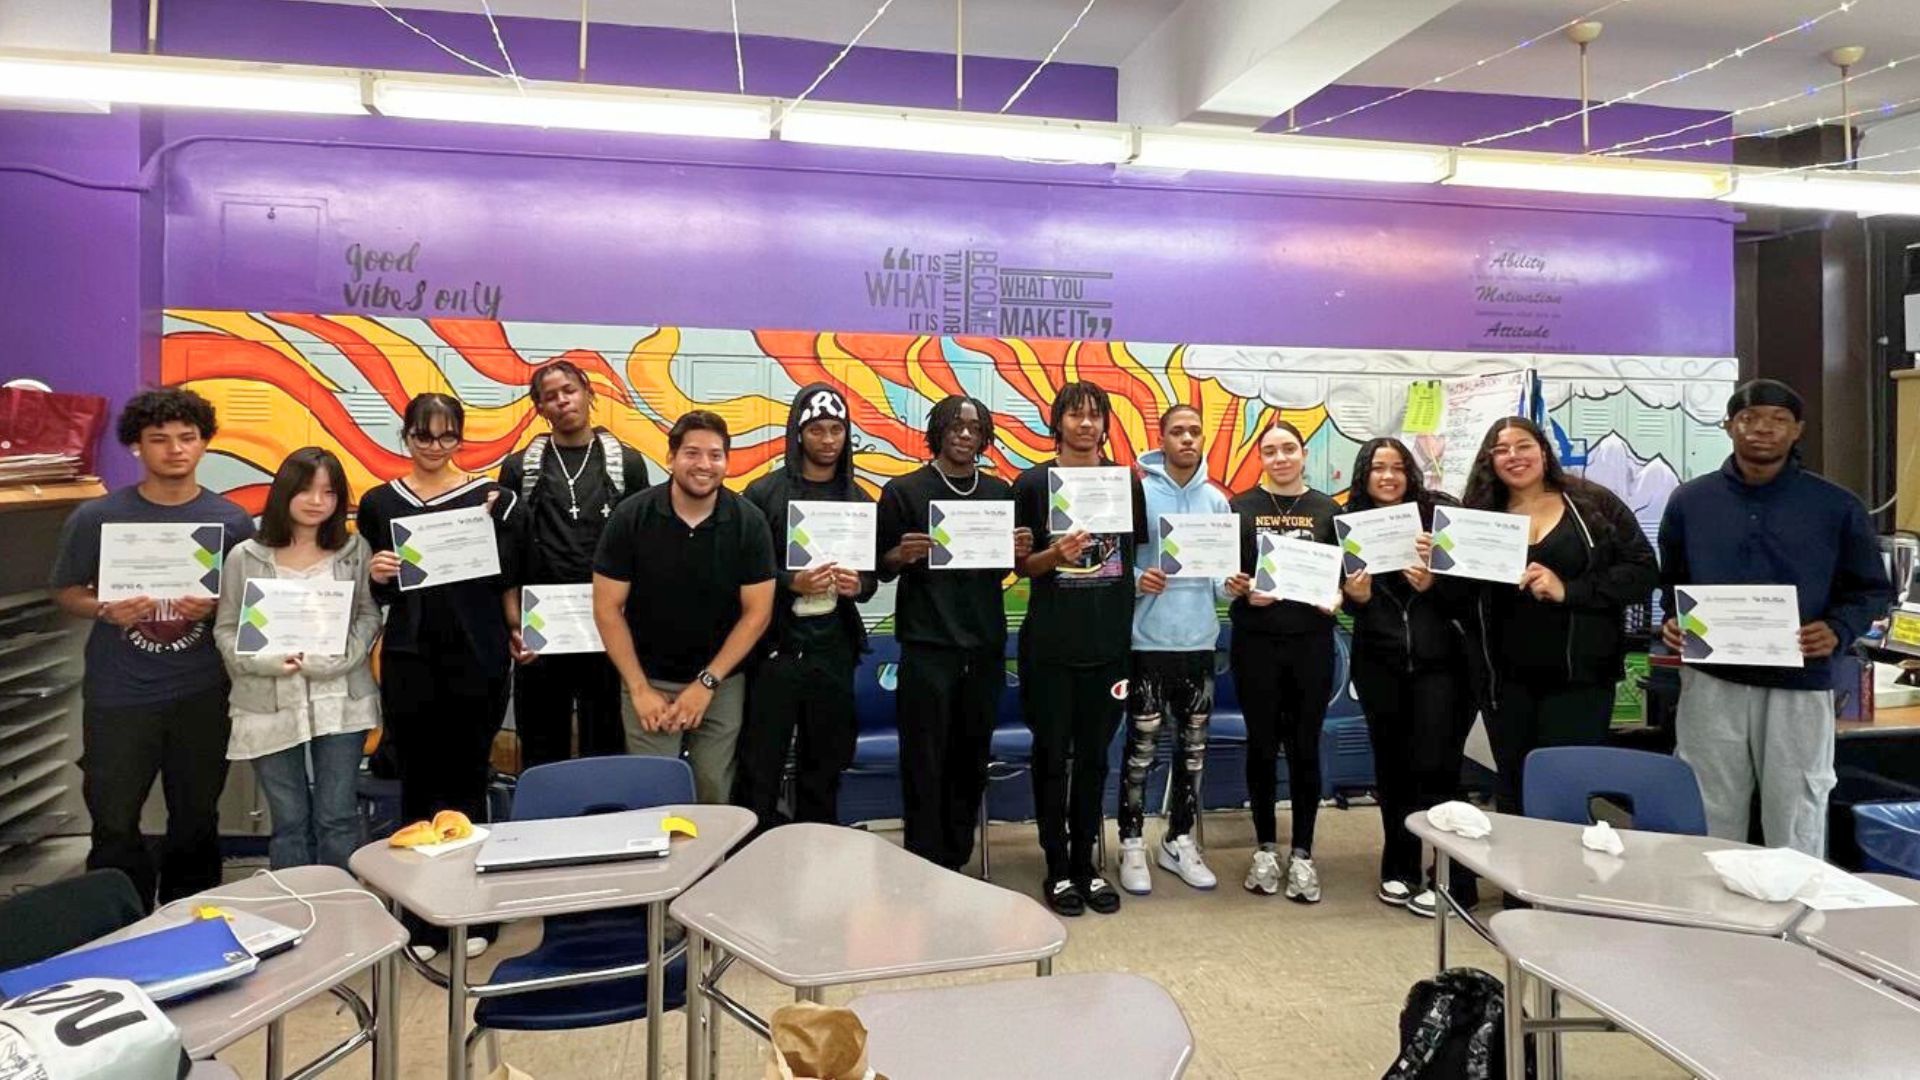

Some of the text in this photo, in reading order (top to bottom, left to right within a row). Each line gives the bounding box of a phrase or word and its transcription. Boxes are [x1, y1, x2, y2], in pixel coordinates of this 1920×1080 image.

[345, 242, 420, 283] good
[928, 255, 940, 272] IS
[1489, 252, 1546, 272] Ability
[344, 278, 503, 320] vibes only
[864, 271, 941, 309] WHAT
[943, 250, 961, 334] BUT IT WILL
[971, 250, 998, 335] BECOME
[999, 276, 1083, 299] WHAT YOU
[1475, 286, 1562, 304] Motivation
[909, 313, 938, 331] IT IS
[1000, 307, 1066, 337] MAKE
[1483, 321, 1550, 338] Attitude
[1256, 515, 1314, 529] NEW YORK
